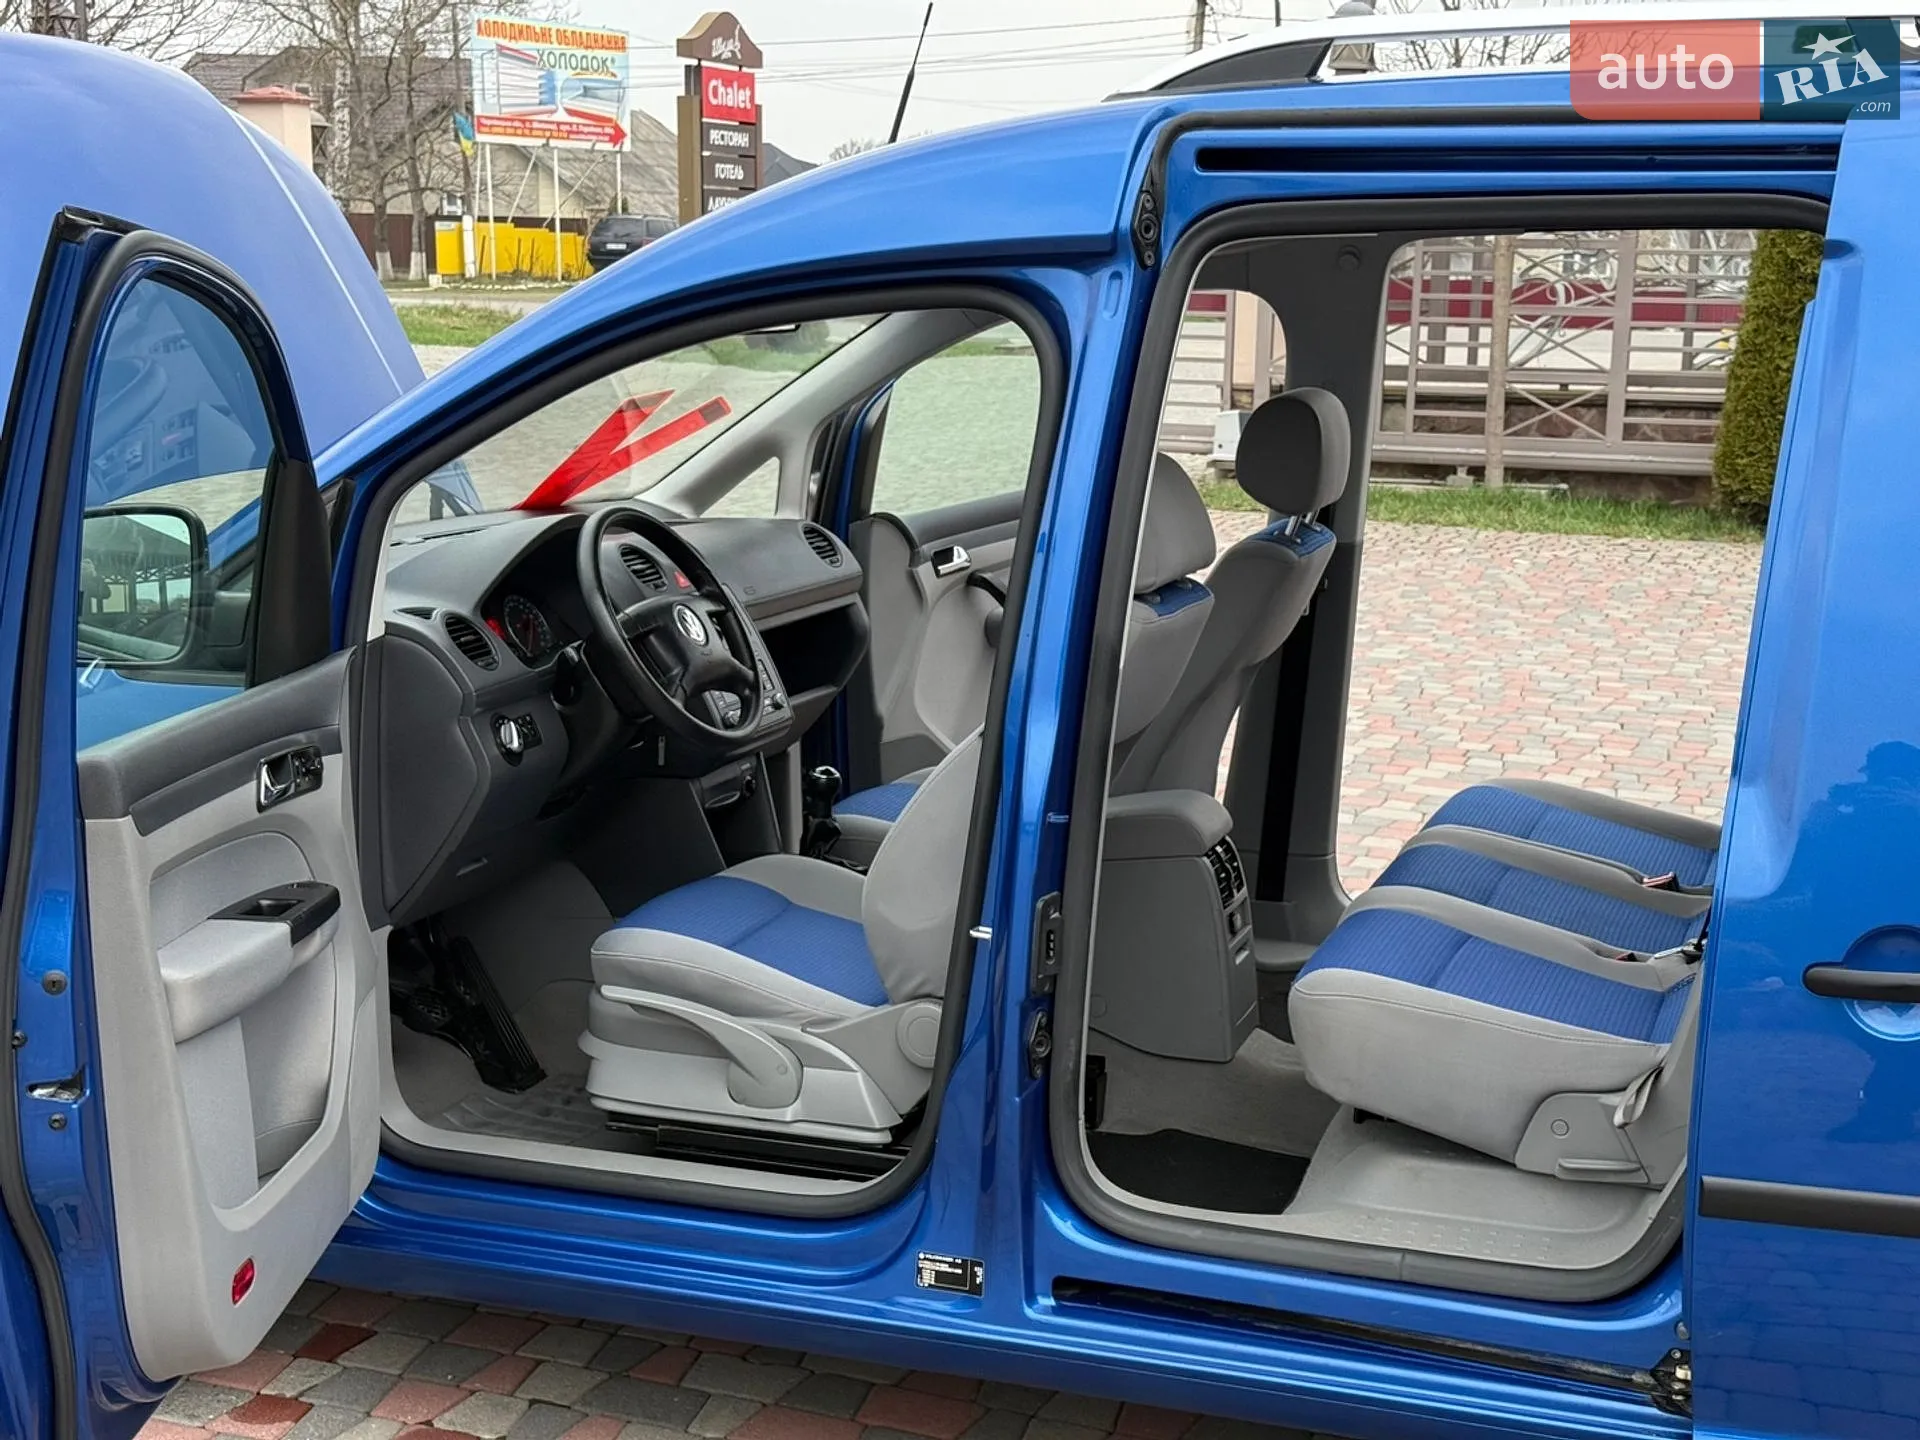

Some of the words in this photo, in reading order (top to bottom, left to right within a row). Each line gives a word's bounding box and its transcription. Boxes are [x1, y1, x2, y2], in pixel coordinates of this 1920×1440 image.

[476, 18, 553, 45] ХОЛОДИЛЬНЕ
[556, 28, 627, 53] ОБЛАДНАННЯ
[708, 79, 751, 110] Chalet
[709, 128, 750, 148] РЕСТОРАН
[714, 162, 744, 180] ГОТЕЛЬ
